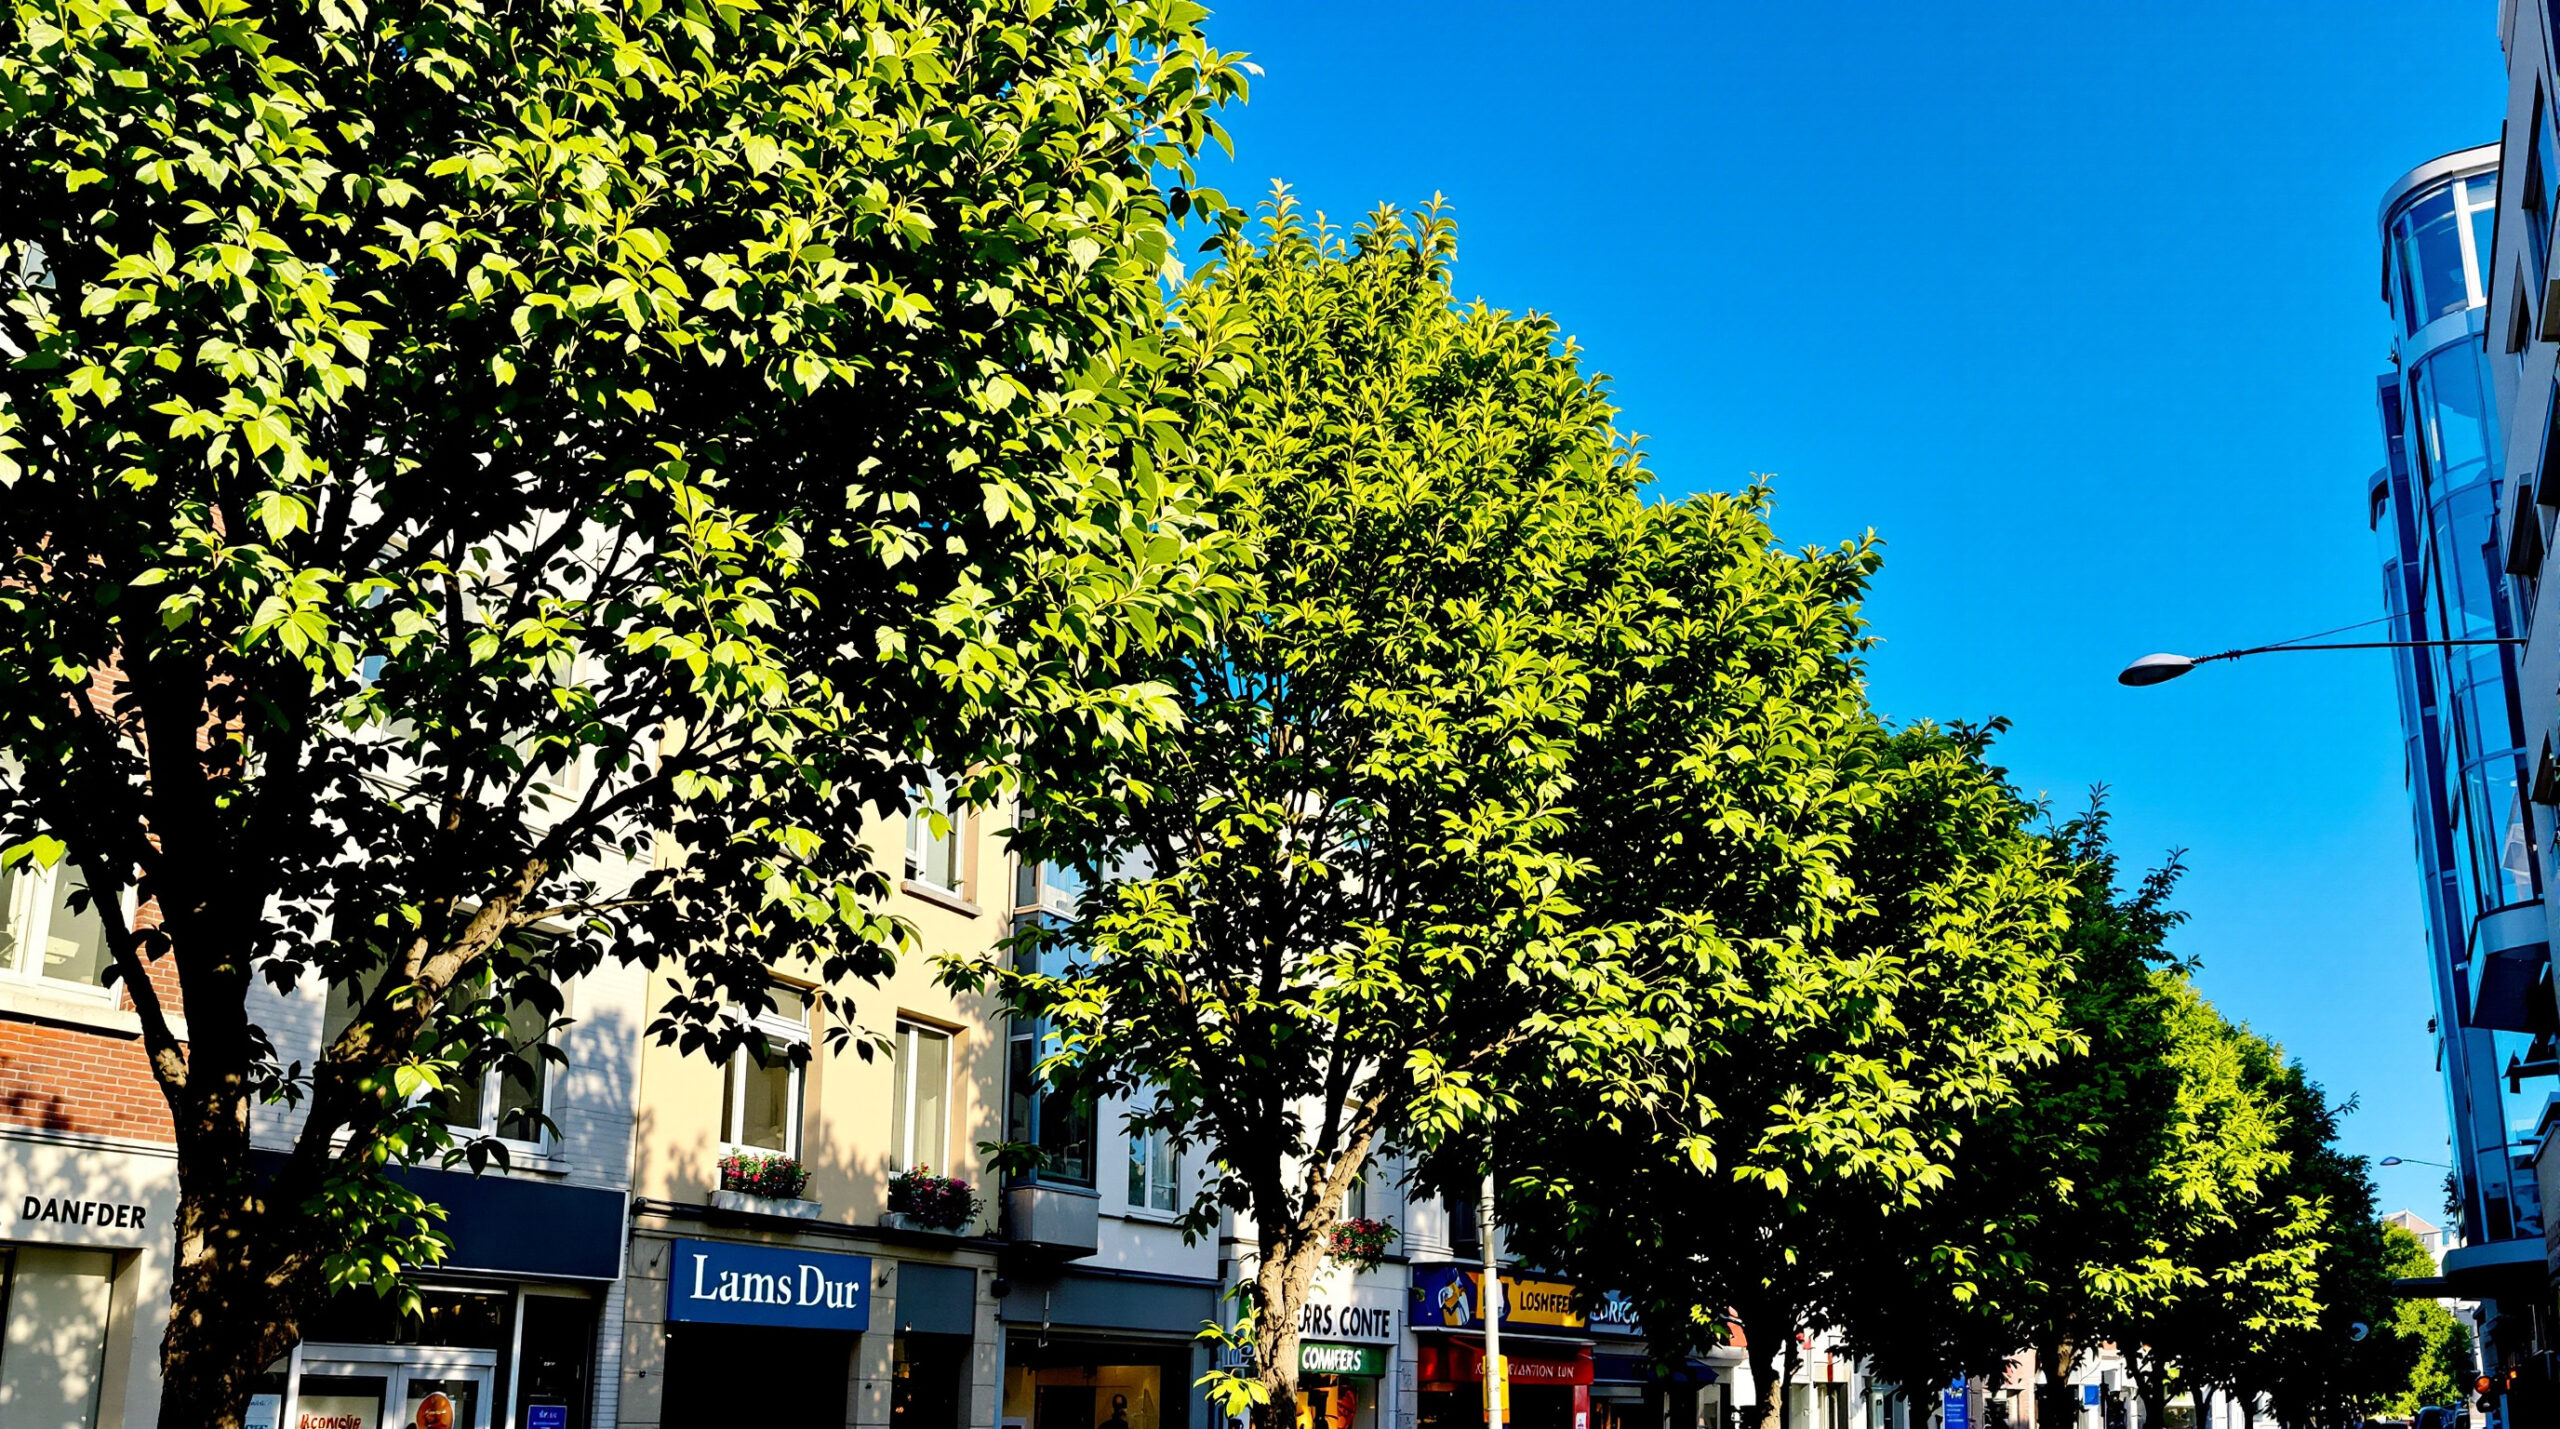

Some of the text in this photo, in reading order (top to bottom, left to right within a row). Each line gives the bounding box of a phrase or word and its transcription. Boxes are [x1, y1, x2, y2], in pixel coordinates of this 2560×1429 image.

[22, 1196, 147, 1229] DANFDER
[690, 1254, 860, 1309] Lams Dur
[1340, 1306, 1390, 1338] CONTE
